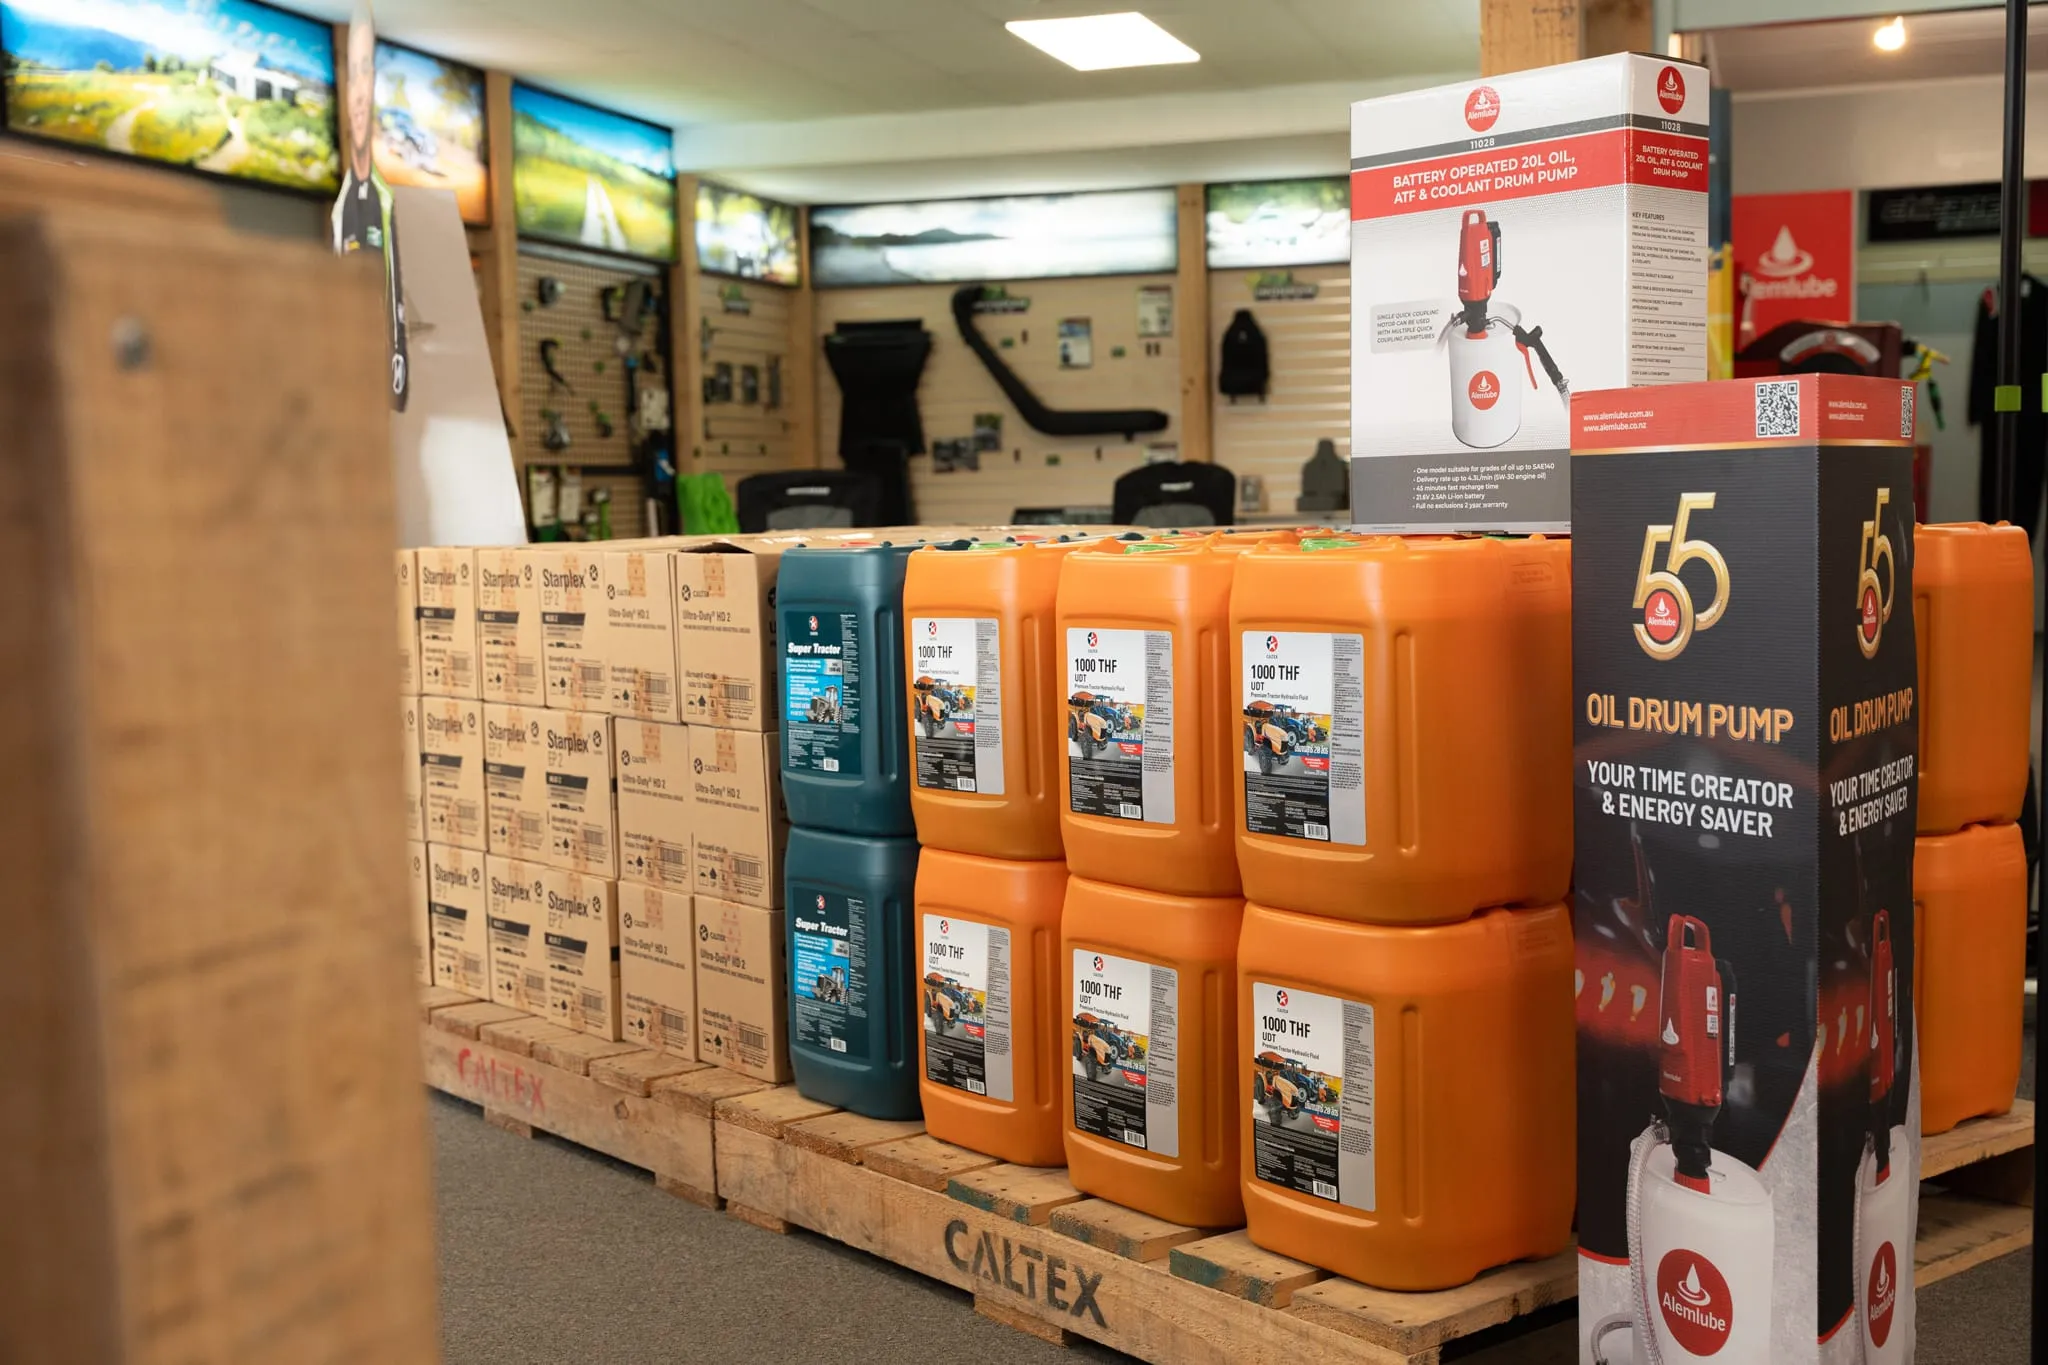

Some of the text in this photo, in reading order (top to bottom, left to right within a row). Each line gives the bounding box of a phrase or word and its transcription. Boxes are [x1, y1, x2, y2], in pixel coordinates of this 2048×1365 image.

[1468, 108, 1497, 120] Alemlube
[1661, 121, 1680, 131] 11028
[1470, 138, 1495, 149] 11028
[1642, 145, 1698, 160] BATTERY OPERATED
[1393, 151, 1575, 188] BATTERY OPERATED 20L OIL,
[1636, 155, 1647, 163] 20L
[1660, 158, 1670, 166] ATF
[1676, 160, 1703, 171] COOLANT
[1653, 168, 1688, 178] DRUM PUMP
[1394, 167, 1578, 204] ATF & COOLANT DRUM PUMP
[1642, 212, 1664, 220] FEATURES
[1583, 410, 1653, 422] www.alemlube.com.au
[1583, 421, 1647, 433] www.alemlube.co.nz
[1479, 465, 1499, 473] grades
[1537, 472, 1546, 480] oil)
[423, 567, 456, 589] Starplex
[483, 568, 520, 592] Starplex
[543, 568, 586, 593] Starplex
[717, 612, 726, 621] HD
[727, 612, 731, 622] 2
[1648, 614, 1676, 627] Alemlube
[788, 642, 841, 655] Super Tractor
[918, 646, 952, 659] 1000 THF
[1075, 658, 1117, 674] 1000 THF
[1251, 664, 1300, 680] 1000 THF
[1075, 674, 1086, 682] UDT
[1251, 682, 1264, 690] UDT
[427, 713, 463, 736] Starplex
[1586, 693, 1794, 743] OIL DRUM PUMP
[1830, 687, 1913, 744] OIL DRUM PUMP
[488, 721, 526, 746] Starplex
[547, 729, 589, 758] Starplex
[653, 777, 661, 788] HD
[661, 778, 666, 789] 2
[1587, 760, 1793, 809] YOUR TIME CREATOR
[1830, 754, 1914, 807] YOUR TIME CREATOR
[727, 786, 736, 798] HD
[736, 789, 741, 799] 2
[1601, 792, 1772, 838] & ENERGY SAVER
[1839, 786, 1908, 836] & ENERGY SAVER
[435, 863, 468, 887] Starplex
[491, 877, 531, 903] Starplex
[548, 891, 589, 918] Starplex
[795, 917, 848, 937] Super Tractor
[929, 942, 964, 960] 1000 THF
[1080, 979, 1122, 1000] 1000 THF
[1080, 994, 1092, 1004] UDT
[1262, 1016, 1311, 1038] 1000 THF
[1262, 1032, 1276, 1043] UDT
[457, 1048, 546, 1115] CALTEX
[944, 1219, 1108, 1329] CALTEX
[1662, 1292, 1726, 1331] Alemlube
[1870, 1288, 1895, 1322] Alemlube
